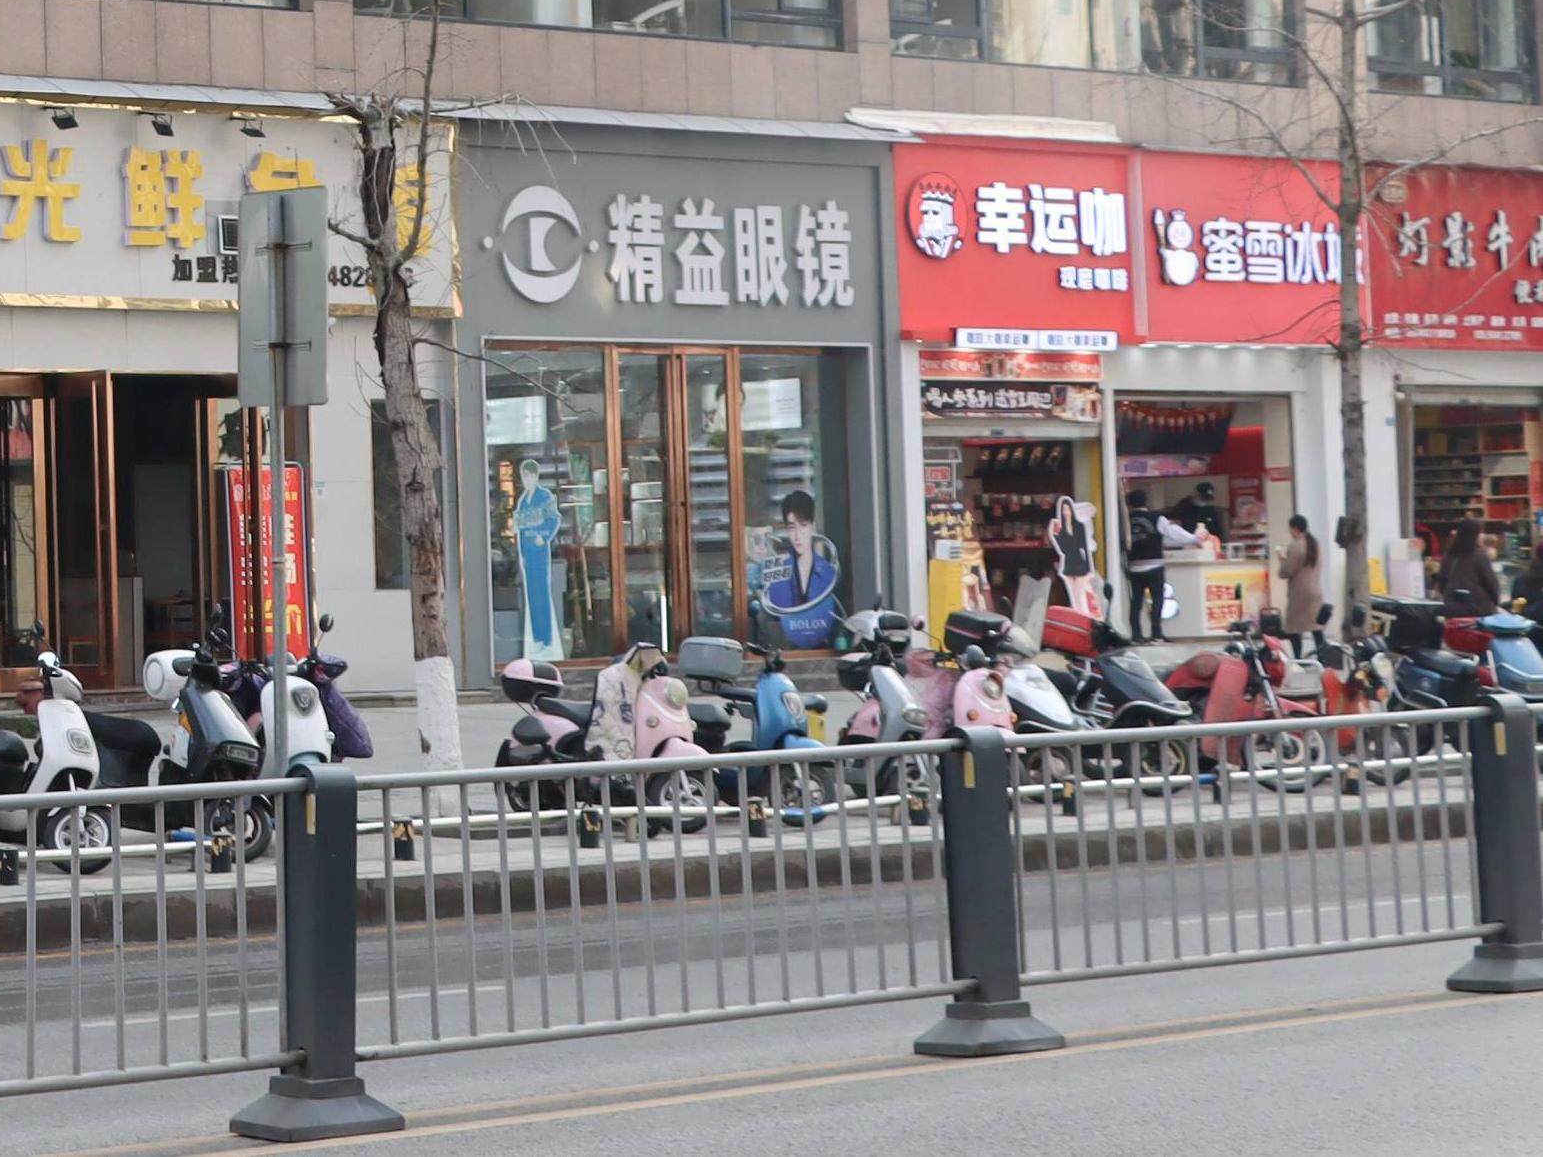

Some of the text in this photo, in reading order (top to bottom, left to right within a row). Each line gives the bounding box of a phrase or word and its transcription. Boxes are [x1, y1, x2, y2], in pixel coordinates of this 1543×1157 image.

[607, 193, 854, 307] 精益眼镜
[975, 181, 1129, 257] 幸运咖
